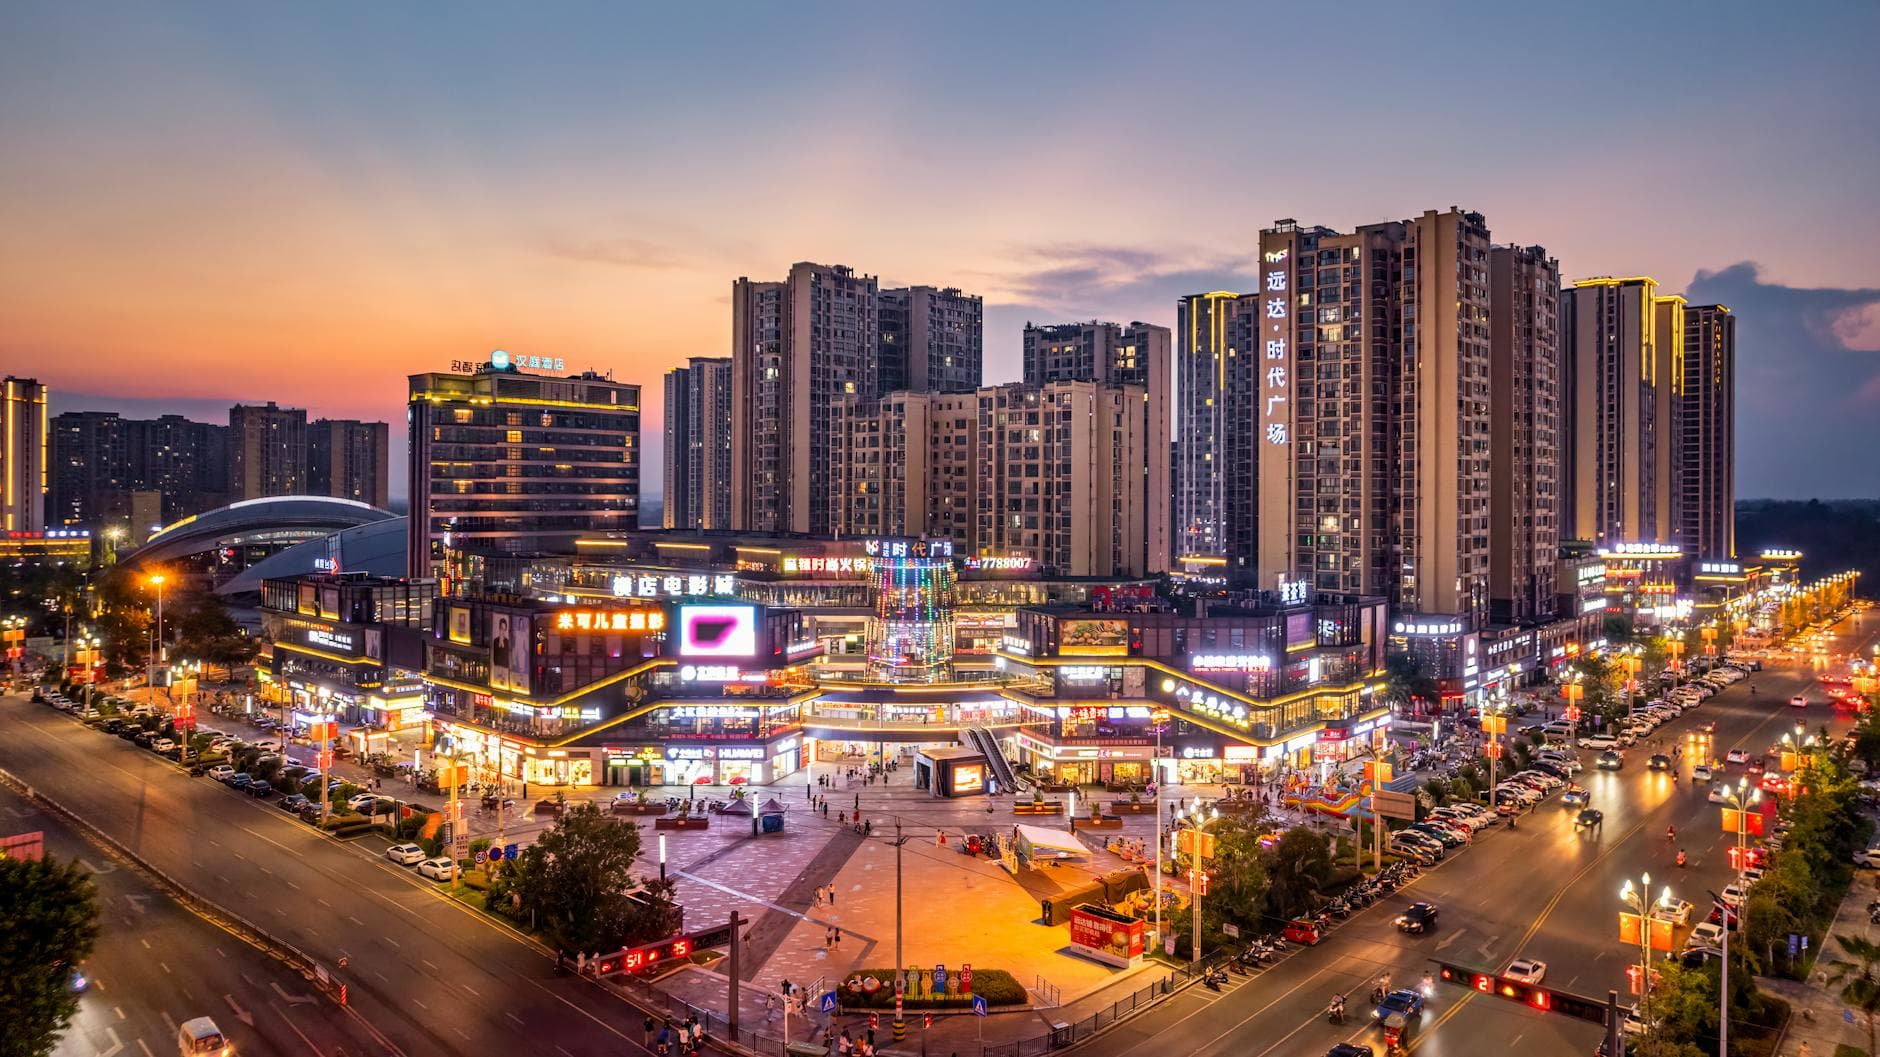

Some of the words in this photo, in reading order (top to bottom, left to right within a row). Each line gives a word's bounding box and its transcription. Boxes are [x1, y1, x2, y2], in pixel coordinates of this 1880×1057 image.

[515, 354, 564, 370] 汉庭酒店
[1267, 271, 1286, 445] 远达·时代广场
[892, 541, 952, 557] 时代广场
[982, 557, 1032, 569] 7788007
[718, 748, 764, 759] HUAWEI
[1479, 977, 1488, 991] 2
